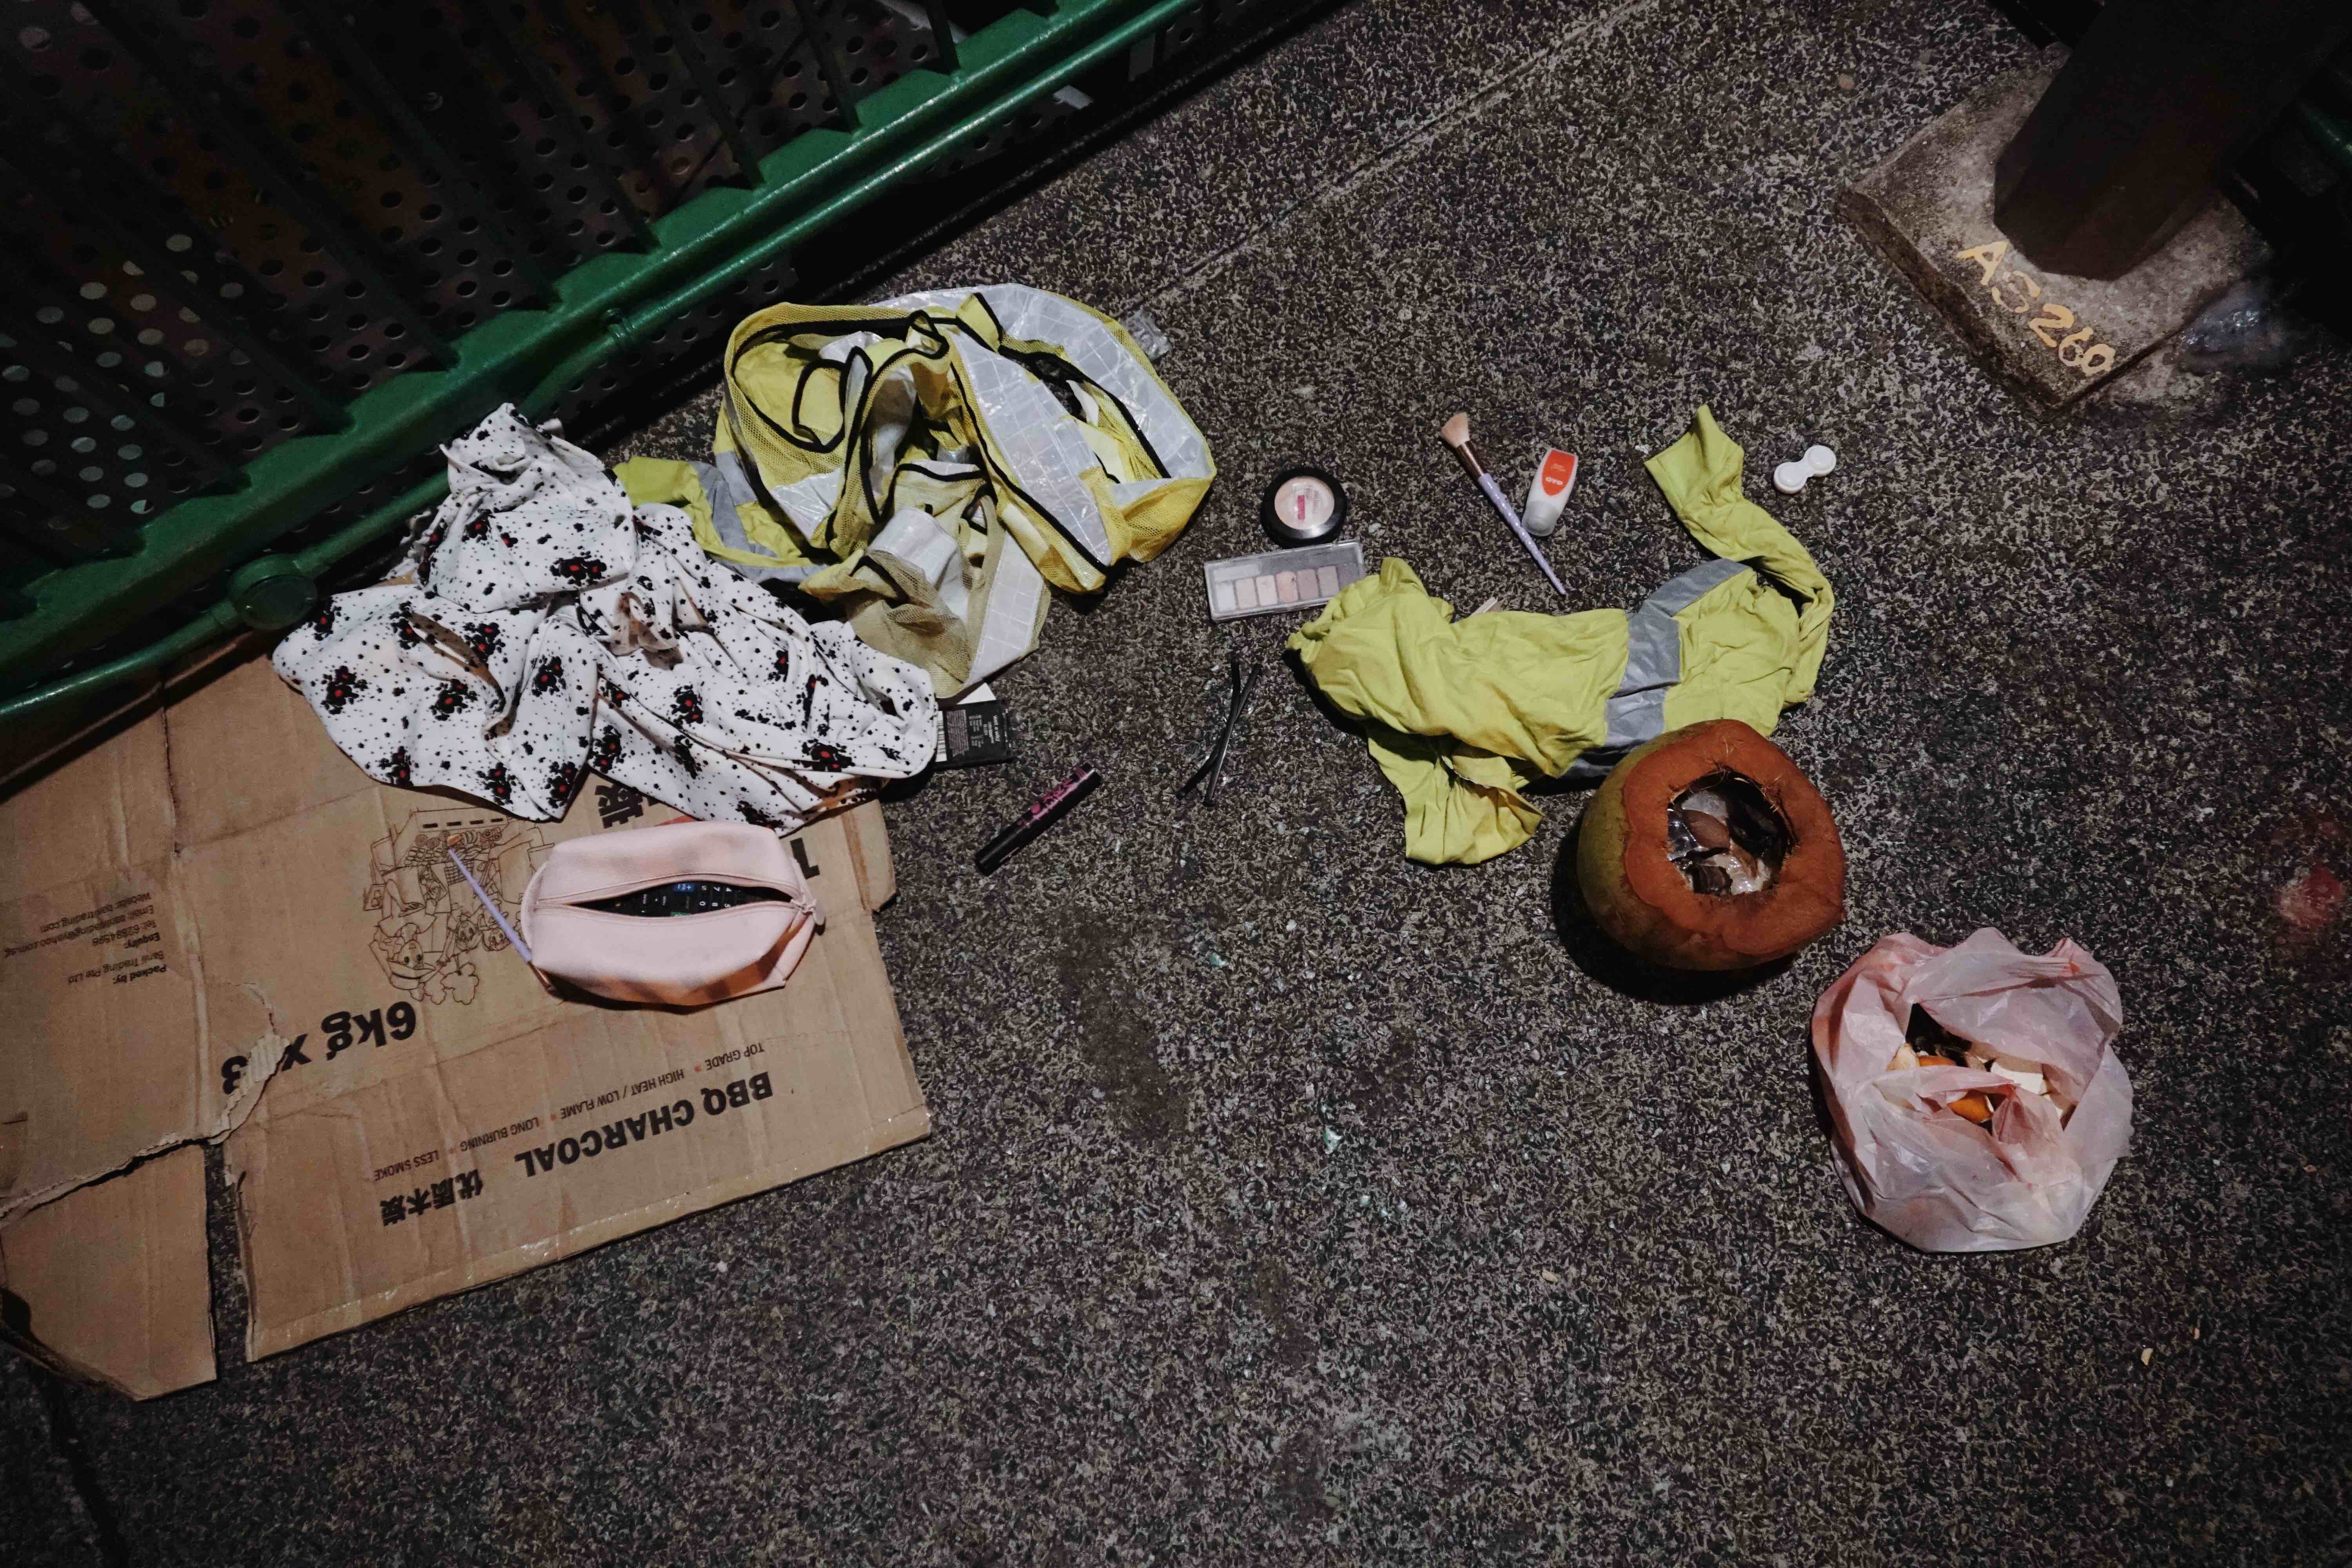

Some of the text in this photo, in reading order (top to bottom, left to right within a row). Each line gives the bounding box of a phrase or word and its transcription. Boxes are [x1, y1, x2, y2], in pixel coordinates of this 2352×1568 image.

[123, 932, 160, 949] Enquiry:
[85, 969, 100, 977] Pte
[102, 957, 138, 974] Trading
[130, 964, 166, 980] Packed
[68, 973, 83, 984] Ltd
[320, 1001, 416, 1061] 6kg
[743, 1042, 764, 1057] TOP
[704, 1048, 740, 1070] GRADE
[221, 1055, 249, 1095] 3
[657, 1068, 684, 1086] HIGH
[630, 1077, 656, 1095] HEAT
[596, 1089, 619, 1106] LOW
[559, 1098, 594, 1119] FLAME
[509, 1116, 539, 1136] LONG
[514, 1071, 773, 1177] BBQ CHARCOAL
[459, 1125, 508, 1151] BURNING
[412, 1149, 439, 1167] LESS
[373, 1159, 411, 1181] SMOKE
[379, 1168, 483, 1226] 优质木炭
